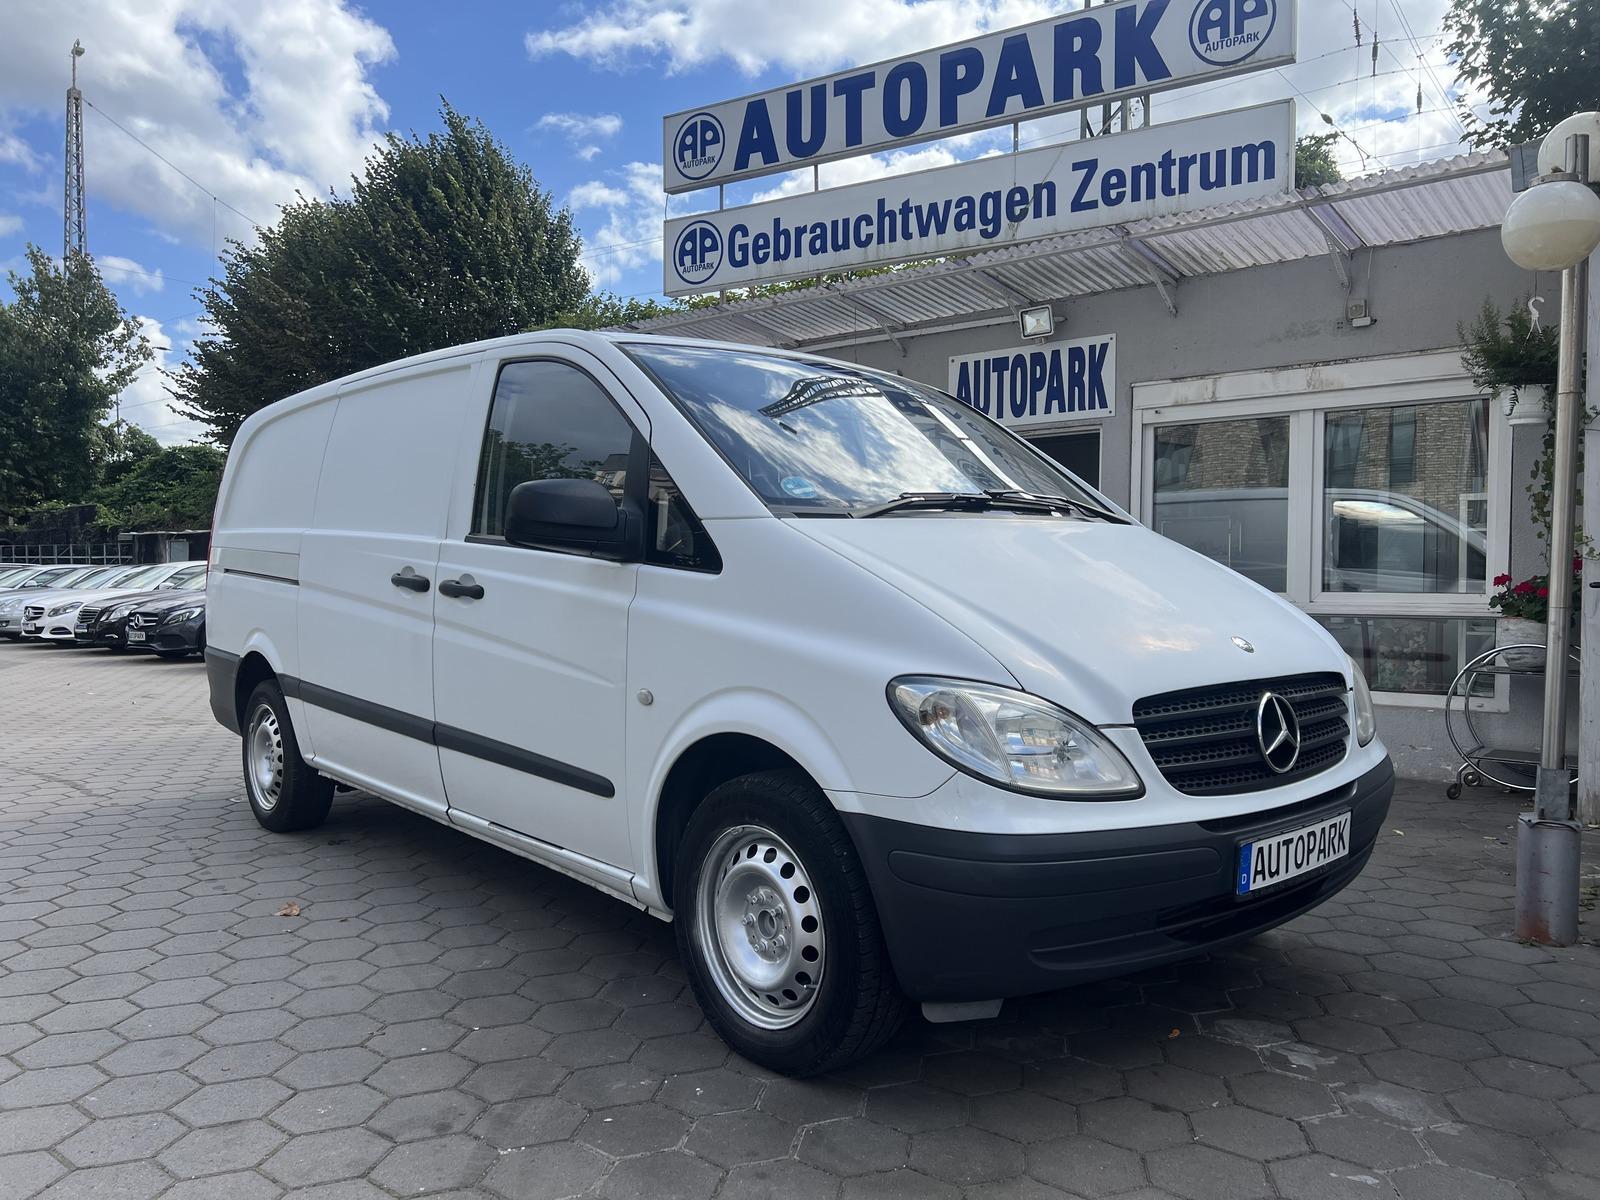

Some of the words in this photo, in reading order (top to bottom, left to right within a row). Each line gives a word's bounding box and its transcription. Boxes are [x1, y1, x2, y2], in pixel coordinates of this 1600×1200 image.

[1204, 31, 1260, 54] AUTOPARK
[733, 0, 1171, 171] AUTOPARK
[678, 119, 720, 162] AP
[682, 155, 716, 170] AUTOPARK
[727, 180, 1057, 269] Gebrauchtwagen
[1070, 140, 1276, 213] Zentrum
[678, 227, 719, 267] AP
[682, 261, 715, 274] AUTOPARK
[956, 342, 1109, 420] AUTOPARK
[1241, 873, 1248, 885] D
[1252, 817, 1348, 884] AUTOPARK
